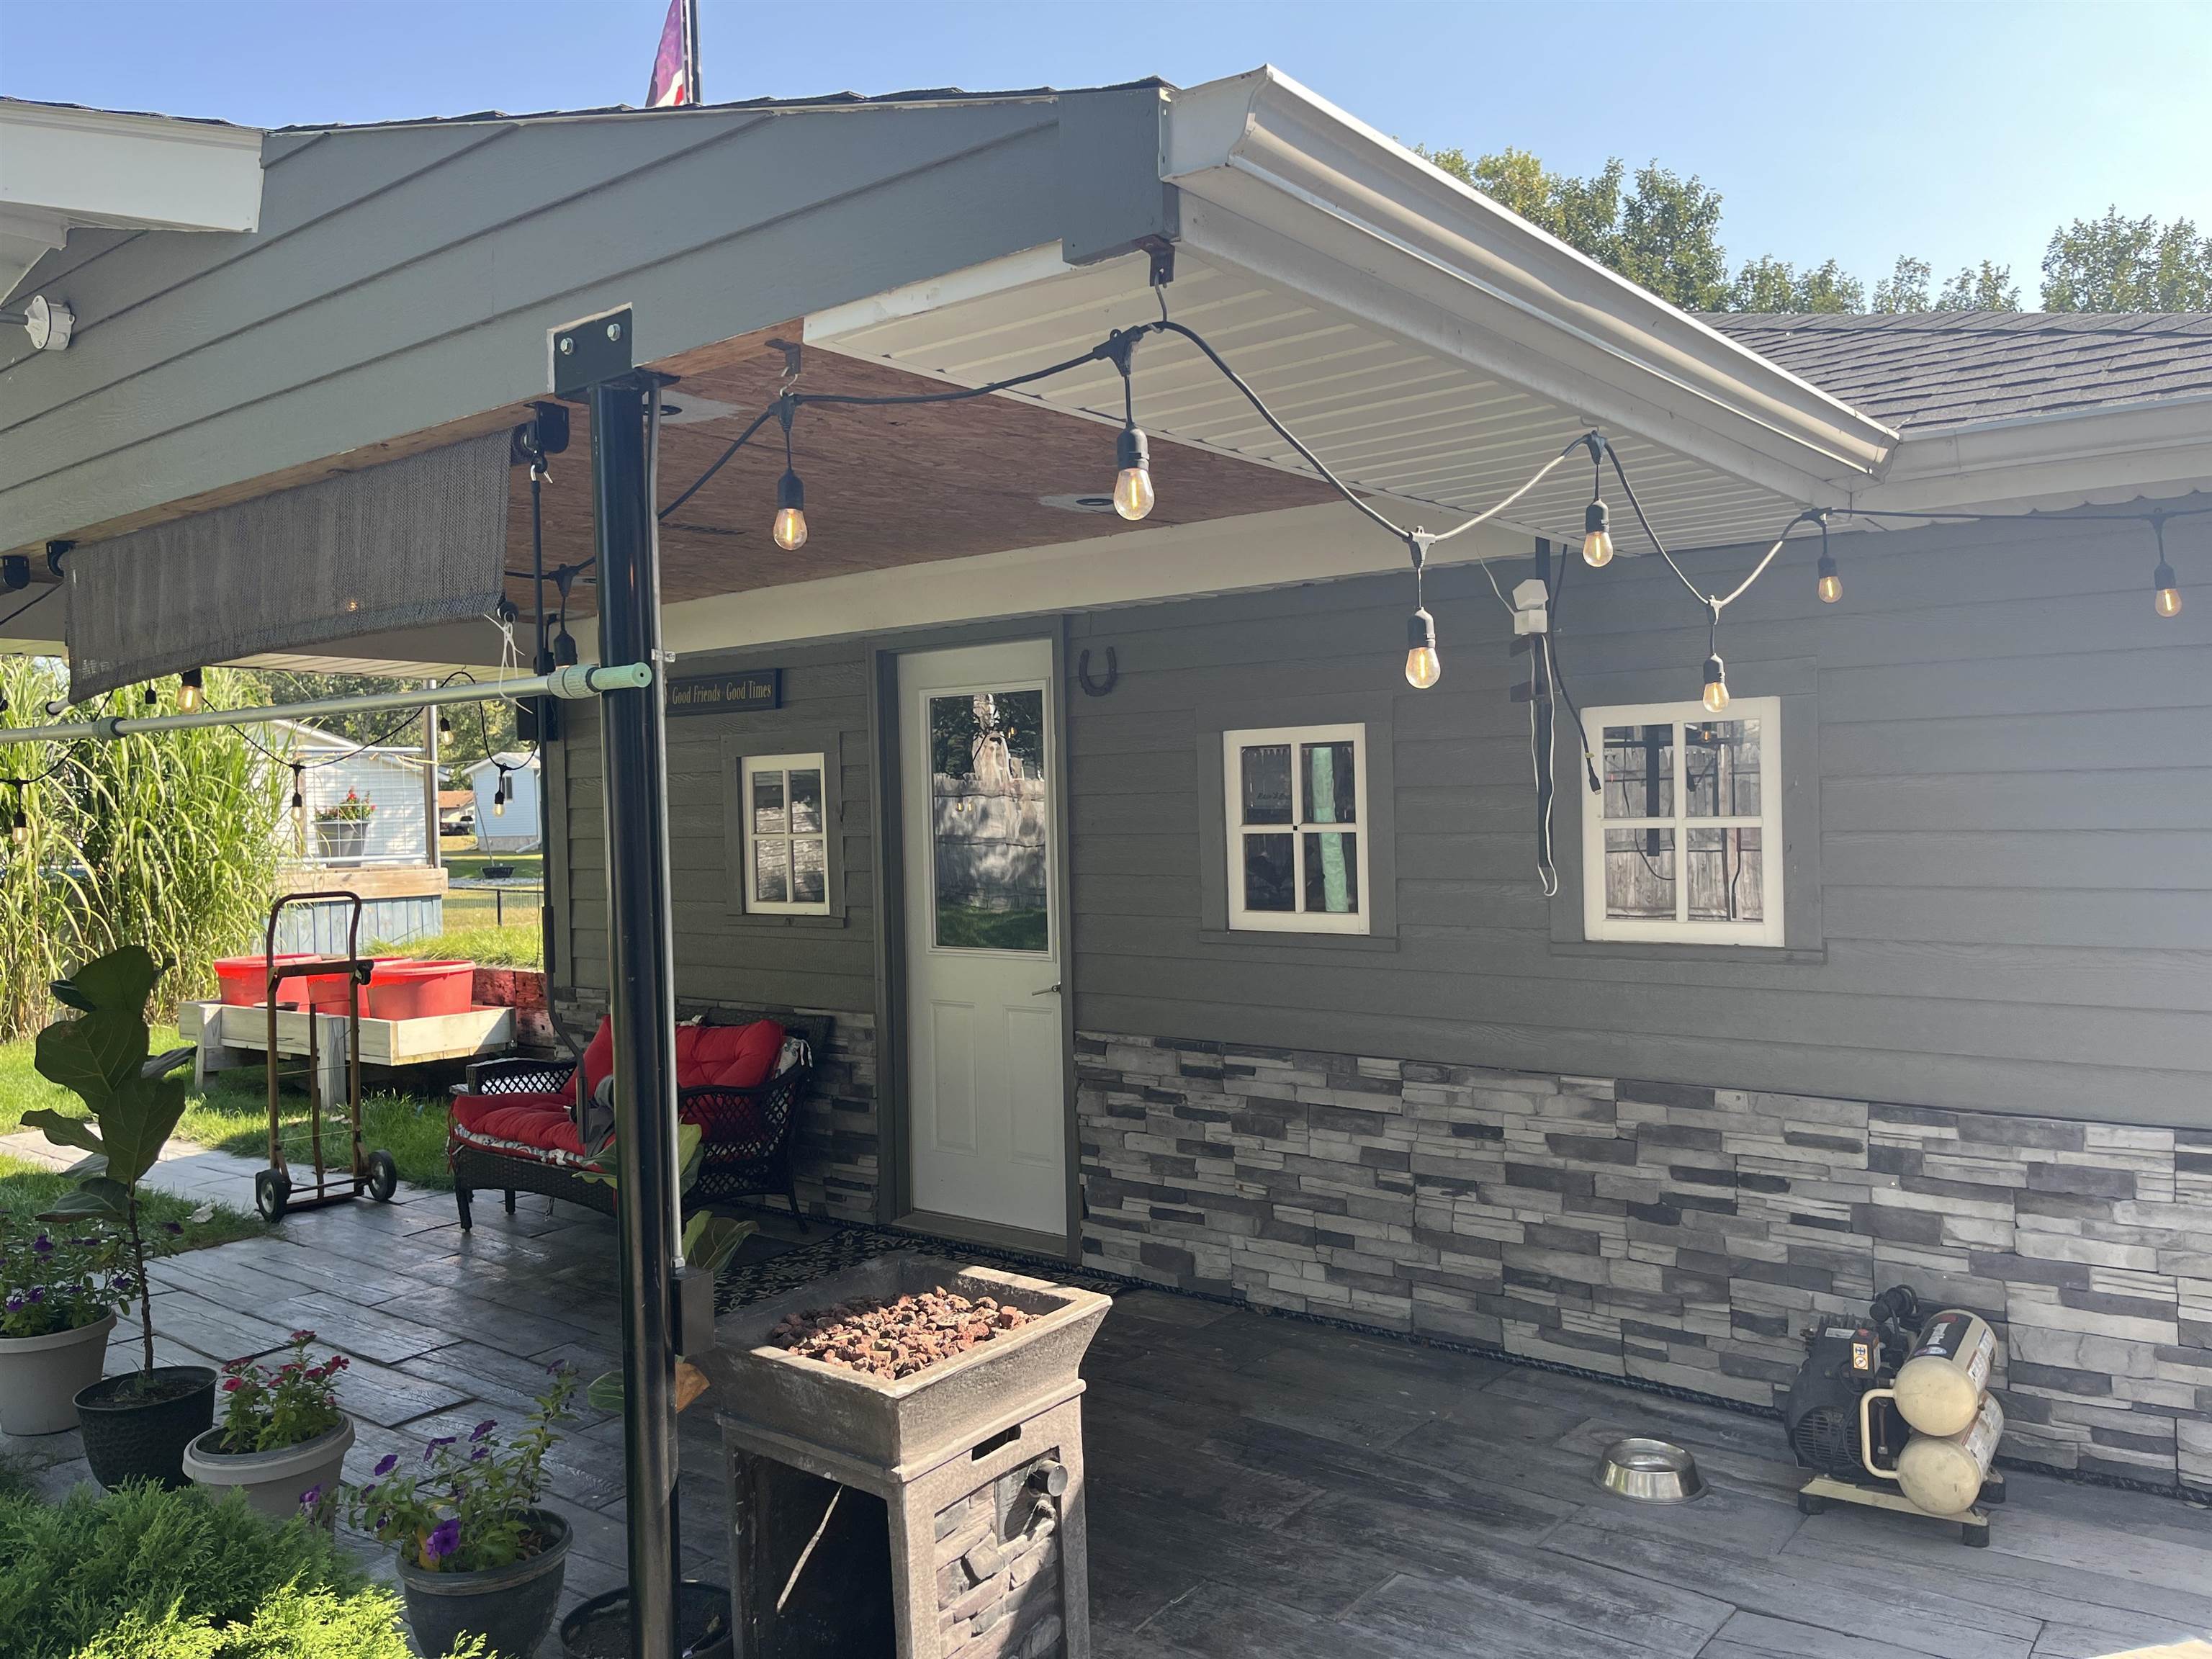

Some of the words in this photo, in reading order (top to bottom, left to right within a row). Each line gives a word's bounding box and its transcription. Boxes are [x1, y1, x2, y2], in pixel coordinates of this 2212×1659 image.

[673, 686, 691, 704] Good
[693, 683, 721, 703] Friends
[726, 681, 745, 700] Good
[748, 680, 772, 698] Times
